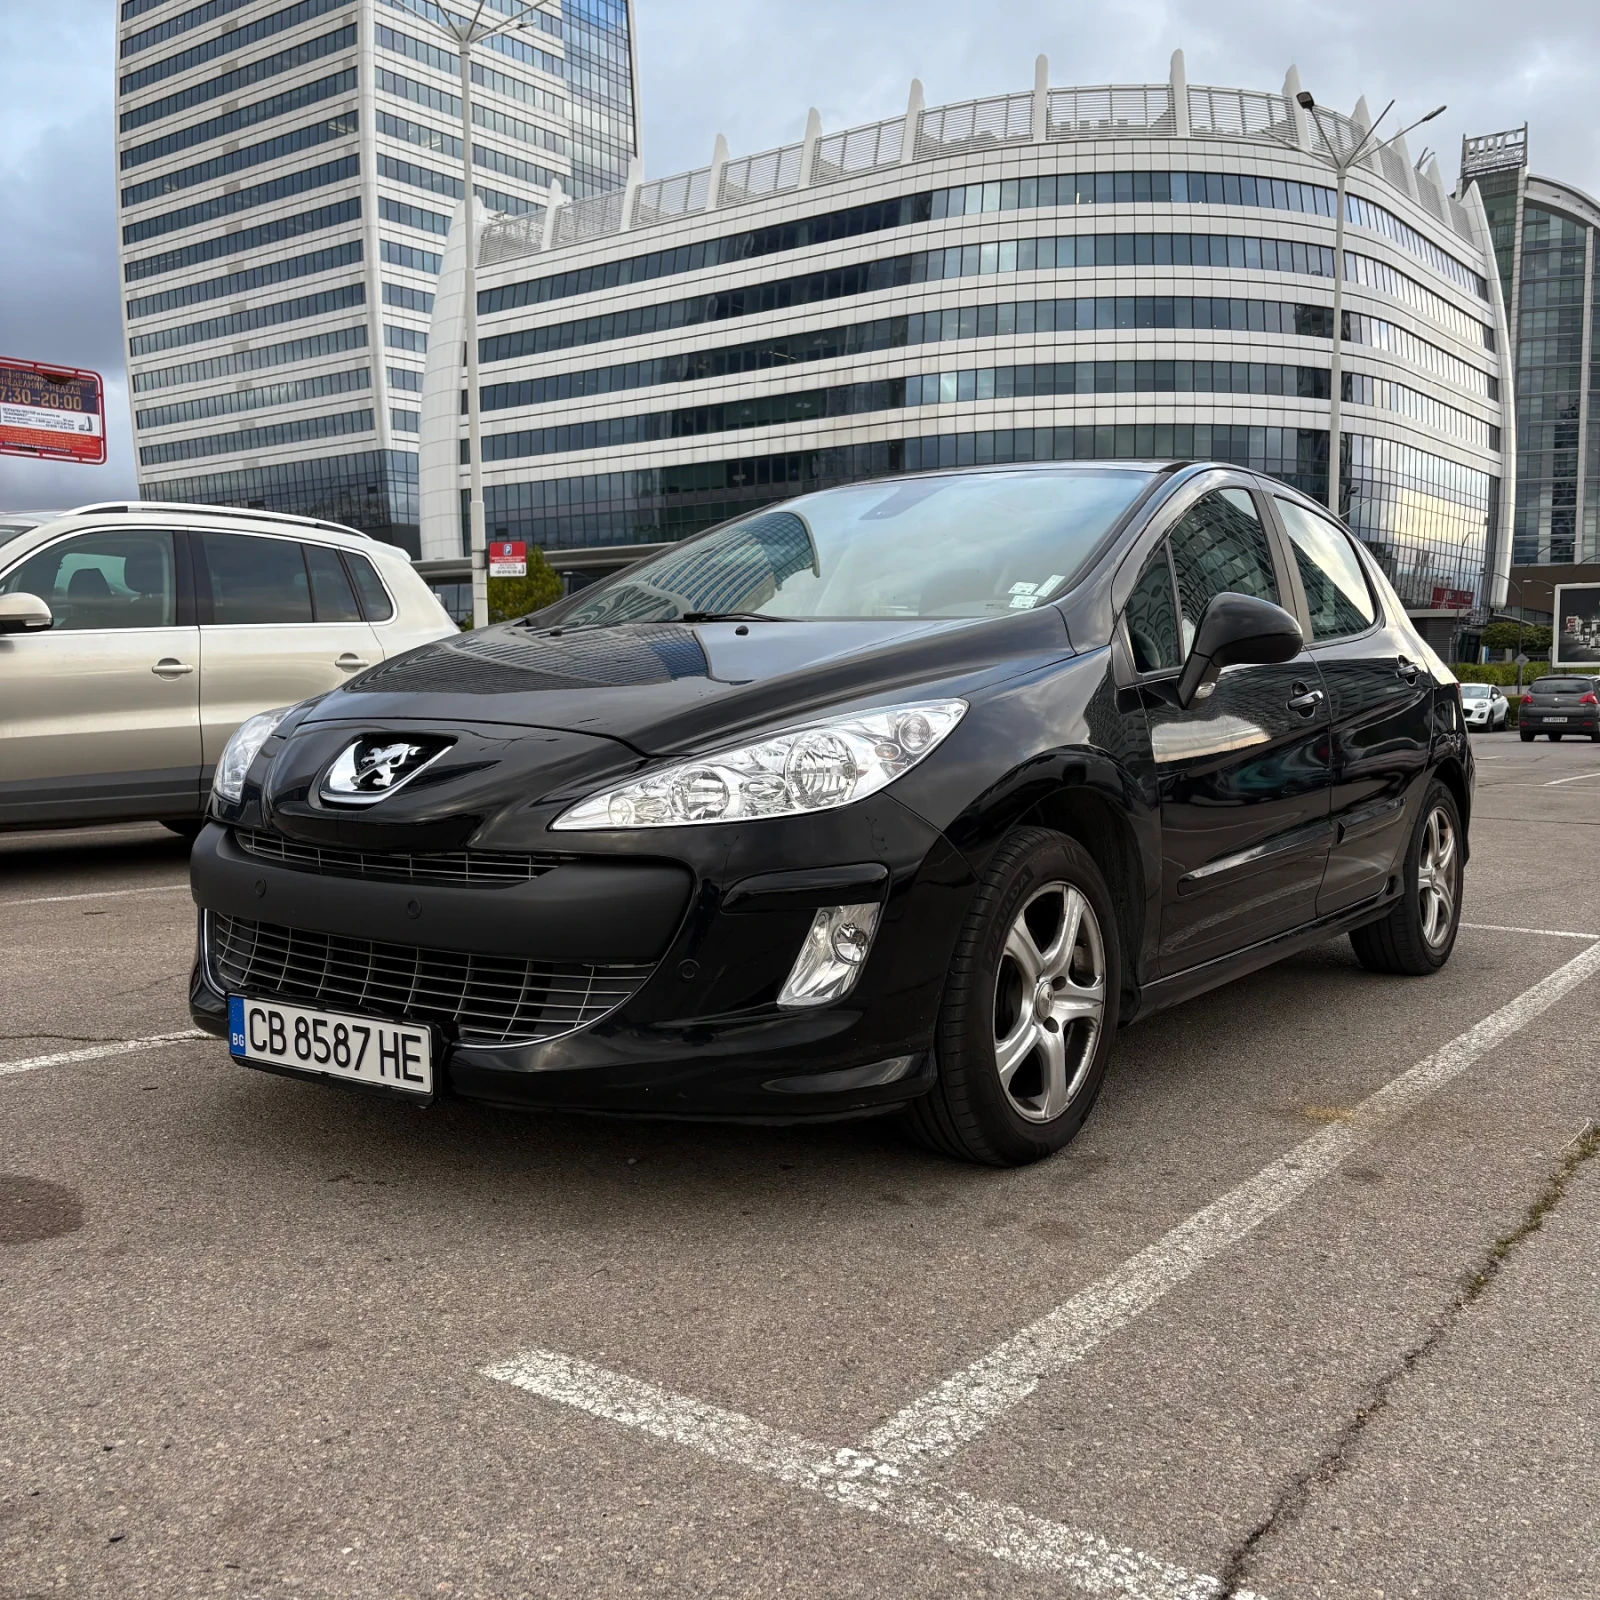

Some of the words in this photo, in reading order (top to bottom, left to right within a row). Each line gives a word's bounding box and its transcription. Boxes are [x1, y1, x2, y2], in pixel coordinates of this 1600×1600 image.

[232, 1033, 245, 1047] BG
[249, 1007, 287, 1056] CB
[294, 1015, 371, 1072] 8587
[379, 1029, 424, 1084] HE
